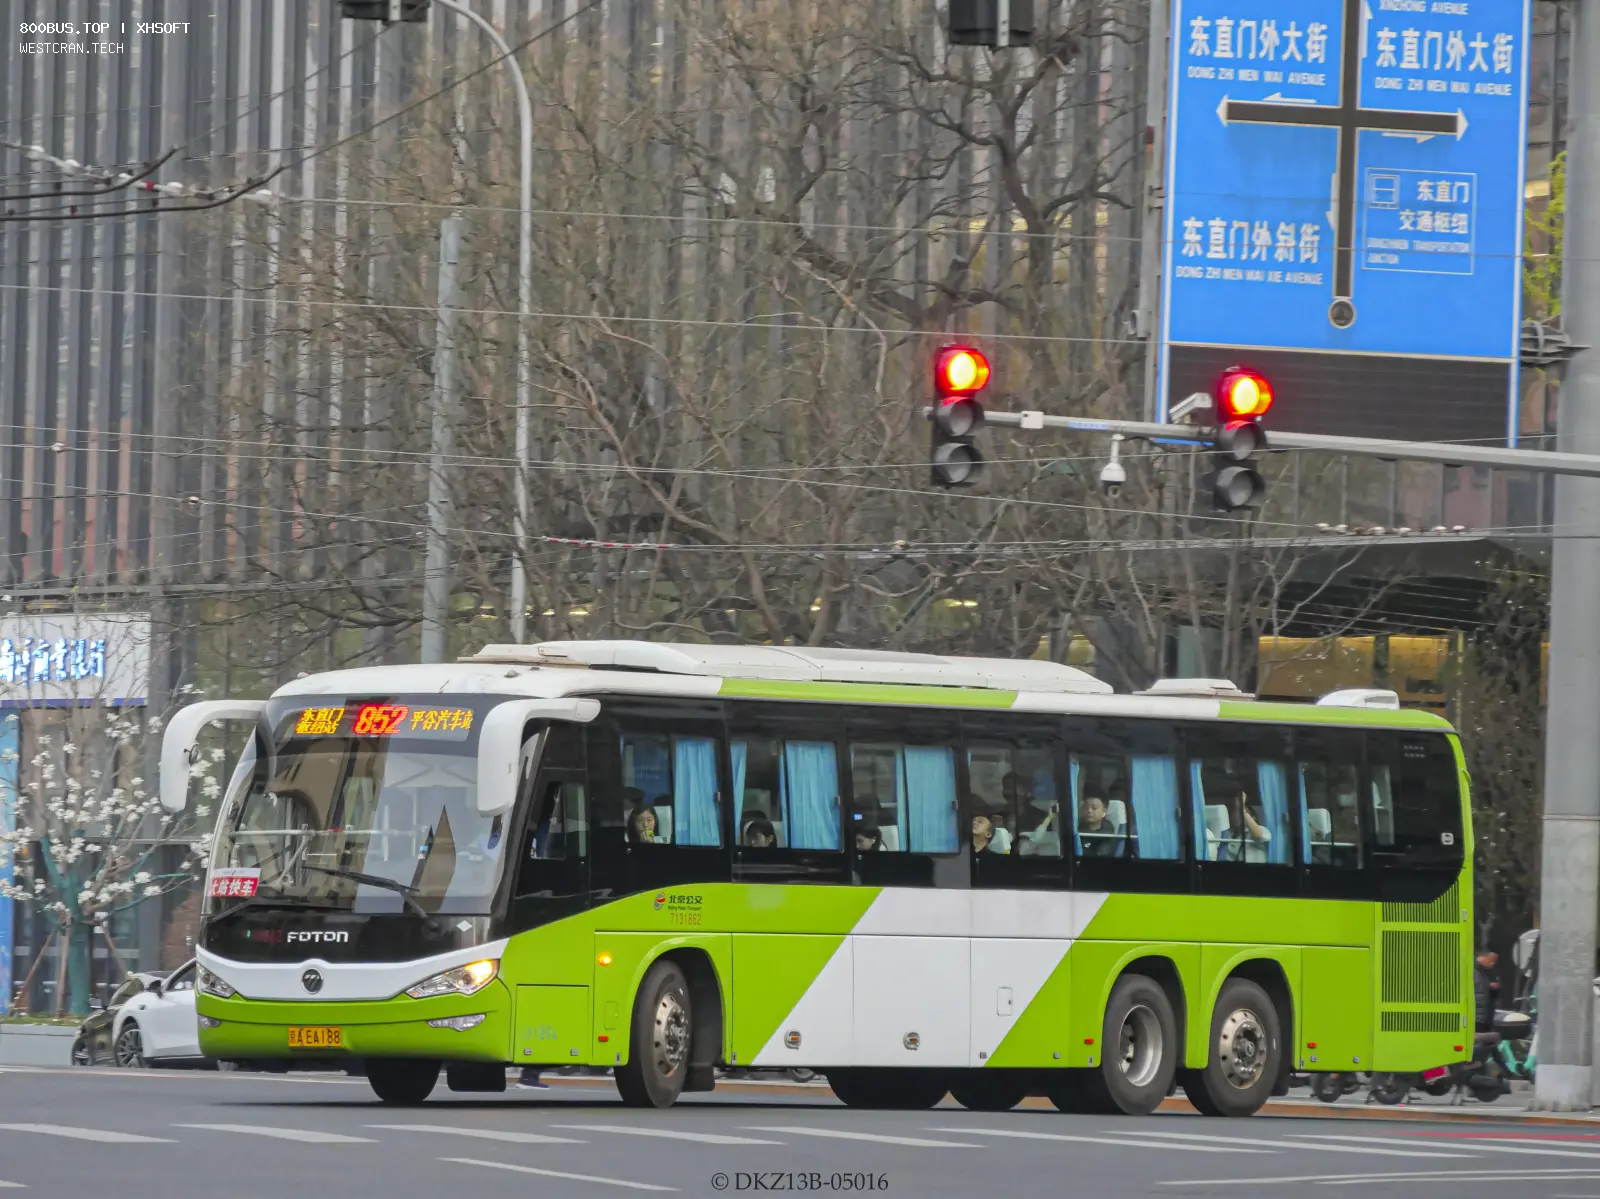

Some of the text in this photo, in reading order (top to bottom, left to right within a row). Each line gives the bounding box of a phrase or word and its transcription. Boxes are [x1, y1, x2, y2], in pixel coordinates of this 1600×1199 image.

[1431, 2, 1469, 15] AVENUE
[1188, 15, 1328, 64] 东直门外大街
[1375, 26, 1514, 74] 东直门外大街
[1187, 65, 1215, 79] DONG
[1218, 67, 1235, 81] ZHI
[1287, 72, 1327, 86] AVENUE
[1374, 76, 1403, 90] DONG
[1407, 78, 1424, 91] ZHI
[1474, 82, 1513, 96] AVENUE
[1416, 180, 1470, 203] 东直门
[1399, 208, 1469, 234] 交通枢纽
[1181, 215, 1321, 264] 东直门外斜街
[1175, 265, 1204, 279] DONG
[1205, 266, 1222, 280] ZHI
[1285, 271, 1324, 285] AVENUE
[302, 707, 345, 722] 东直门
[354, 704, 409, 735] 852
[410, 709, 474, 732] 平谷汽车站
[295, 721, 340, 735] 枢纽站
[668, 895, 703, 905] 北京公交
[670, 913, 702, 926] 7131862
[287, 931, 349, 943] FOTON
